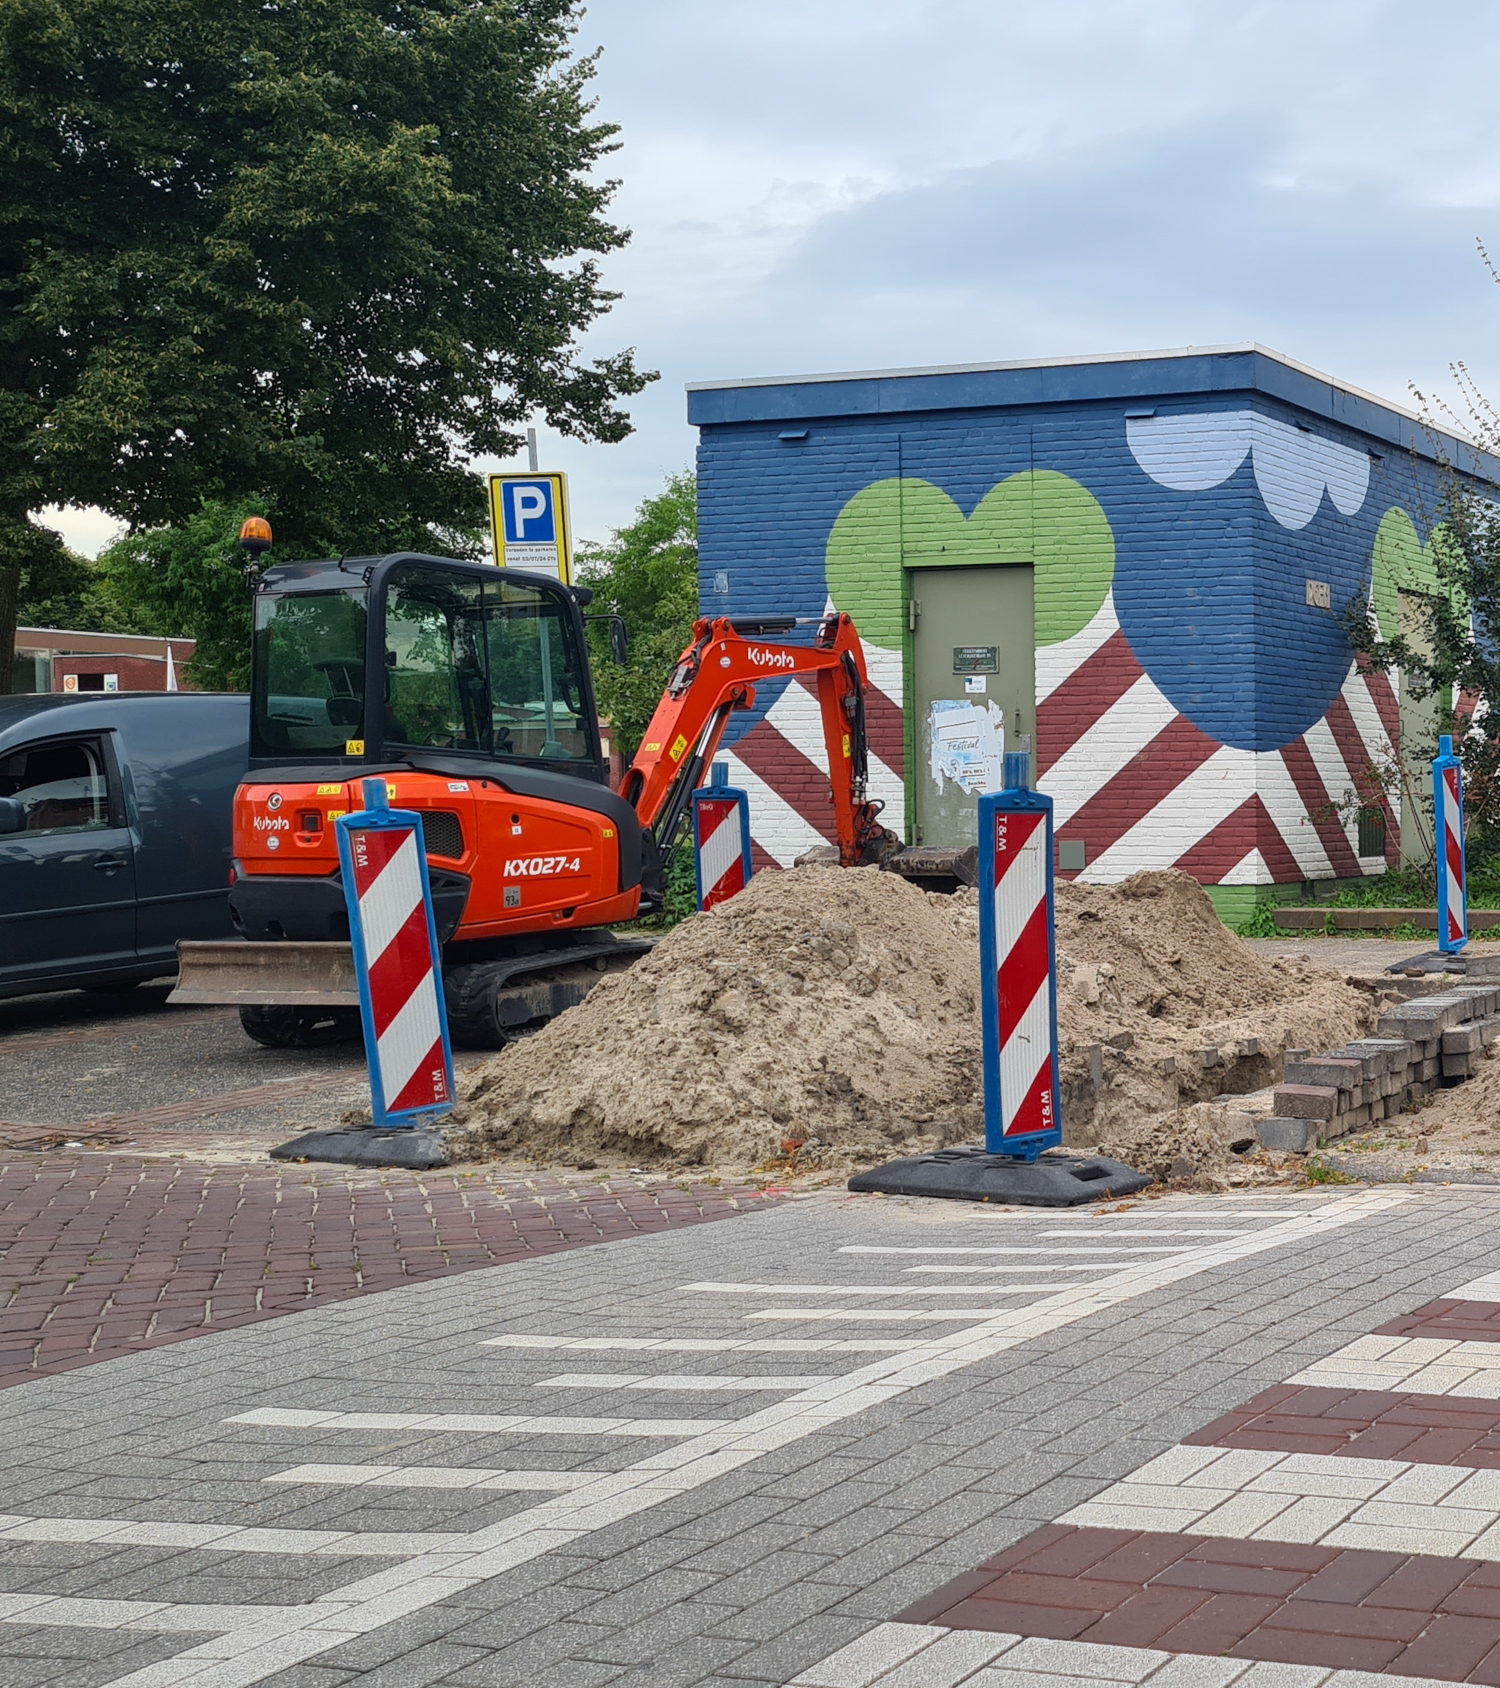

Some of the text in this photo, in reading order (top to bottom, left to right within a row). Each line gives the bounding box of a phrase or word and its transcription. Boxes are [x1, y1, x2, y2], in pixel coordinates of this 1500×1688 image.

[512, 486, 547, 539] P
[747, 647, 795, 668] Kubota
[946, 738, 980, 751] Festival
[253, 816, 290, 831] Kubota
[503, 856, 581, 877] KX027-4
